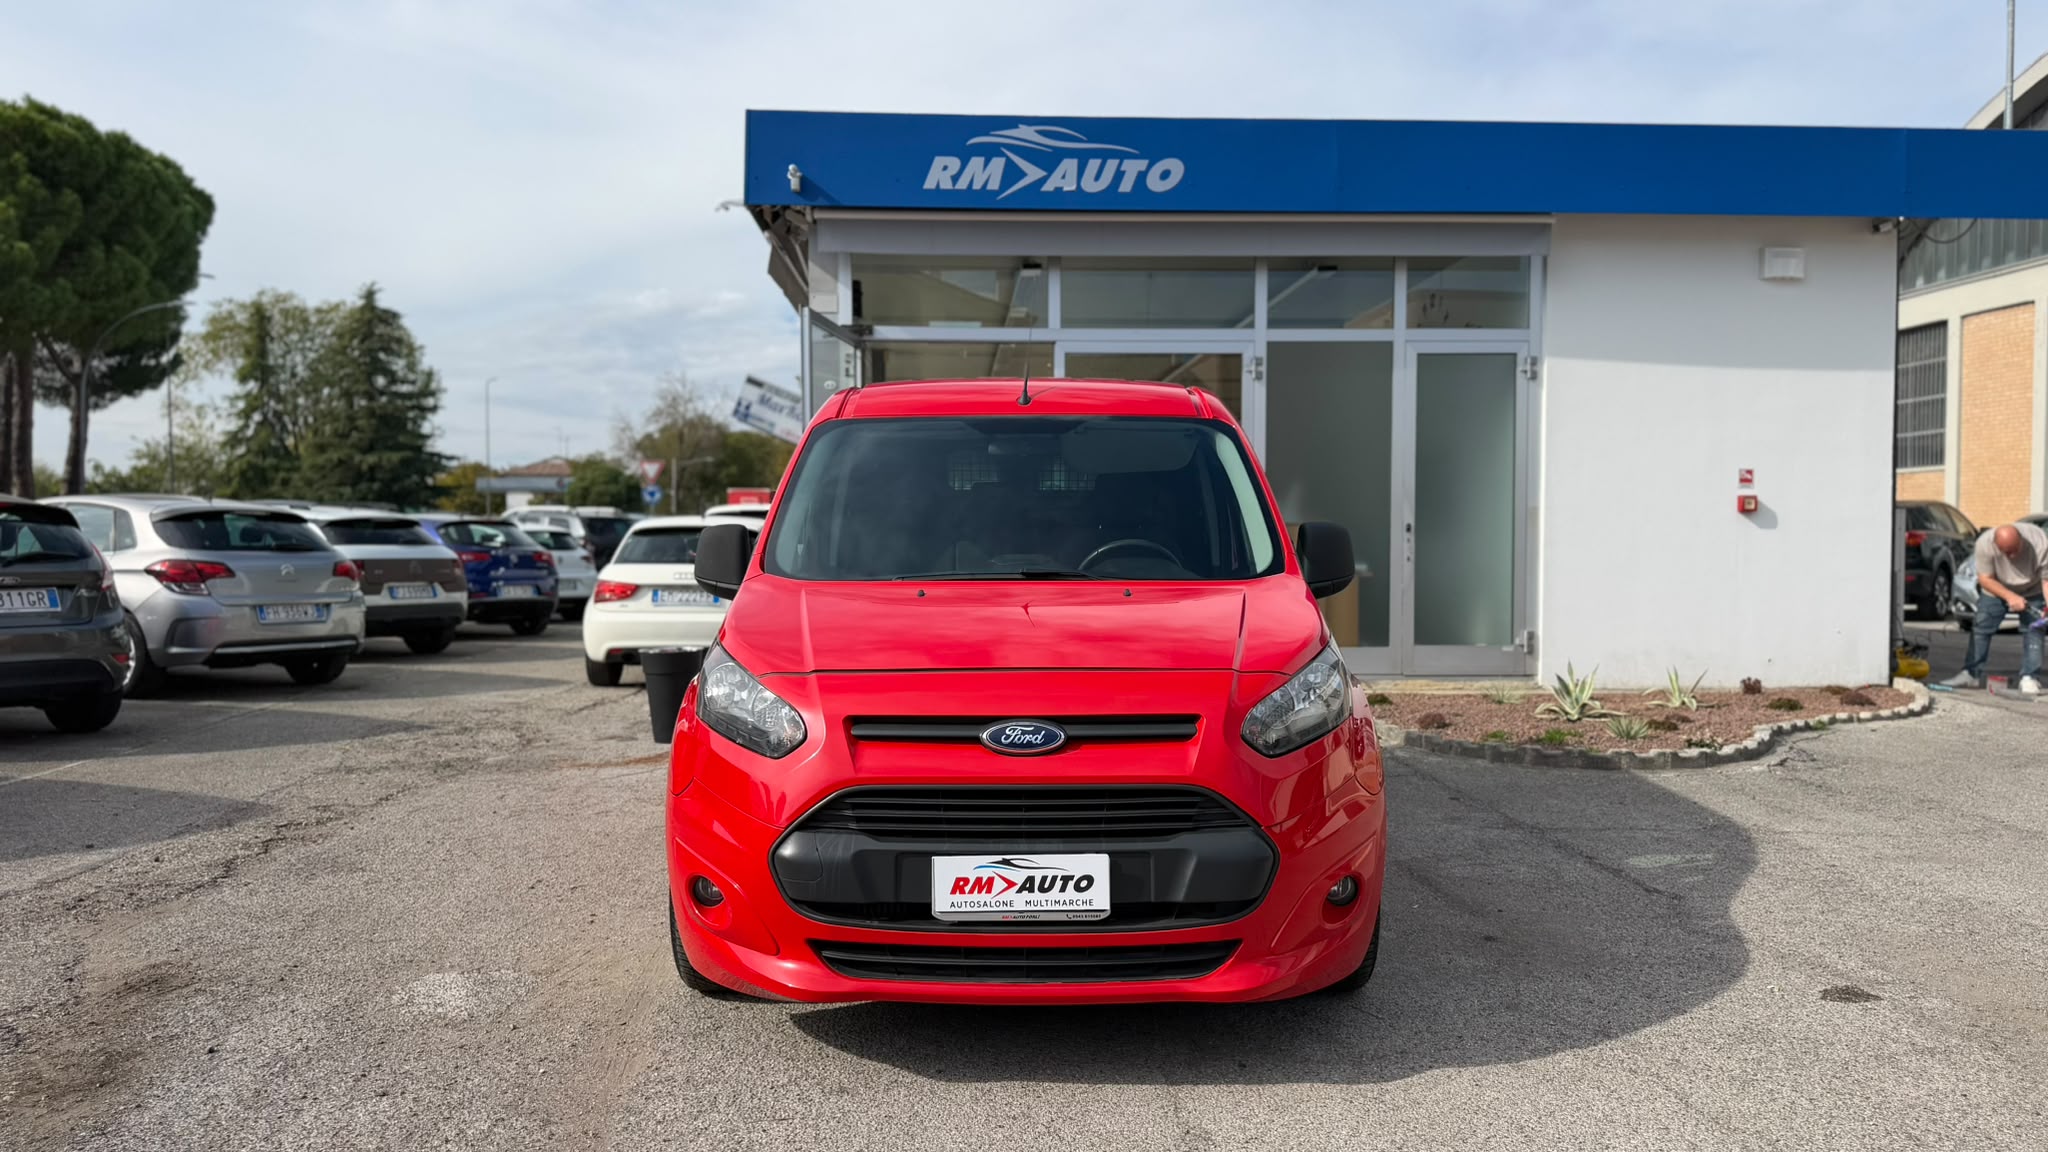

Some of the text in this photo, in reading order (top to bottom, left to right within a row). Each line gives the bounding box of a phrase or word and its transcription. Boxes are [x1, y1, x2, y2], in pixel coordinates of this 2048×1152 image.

[1040, 157, 1186, 193] AUTO
[1001, 725, 1046, 745] Ford
[949, 874, 1095, 895] RM AUTO
[949, 899, 1094, 909] AUTOSALONE MULTIMARCHE
